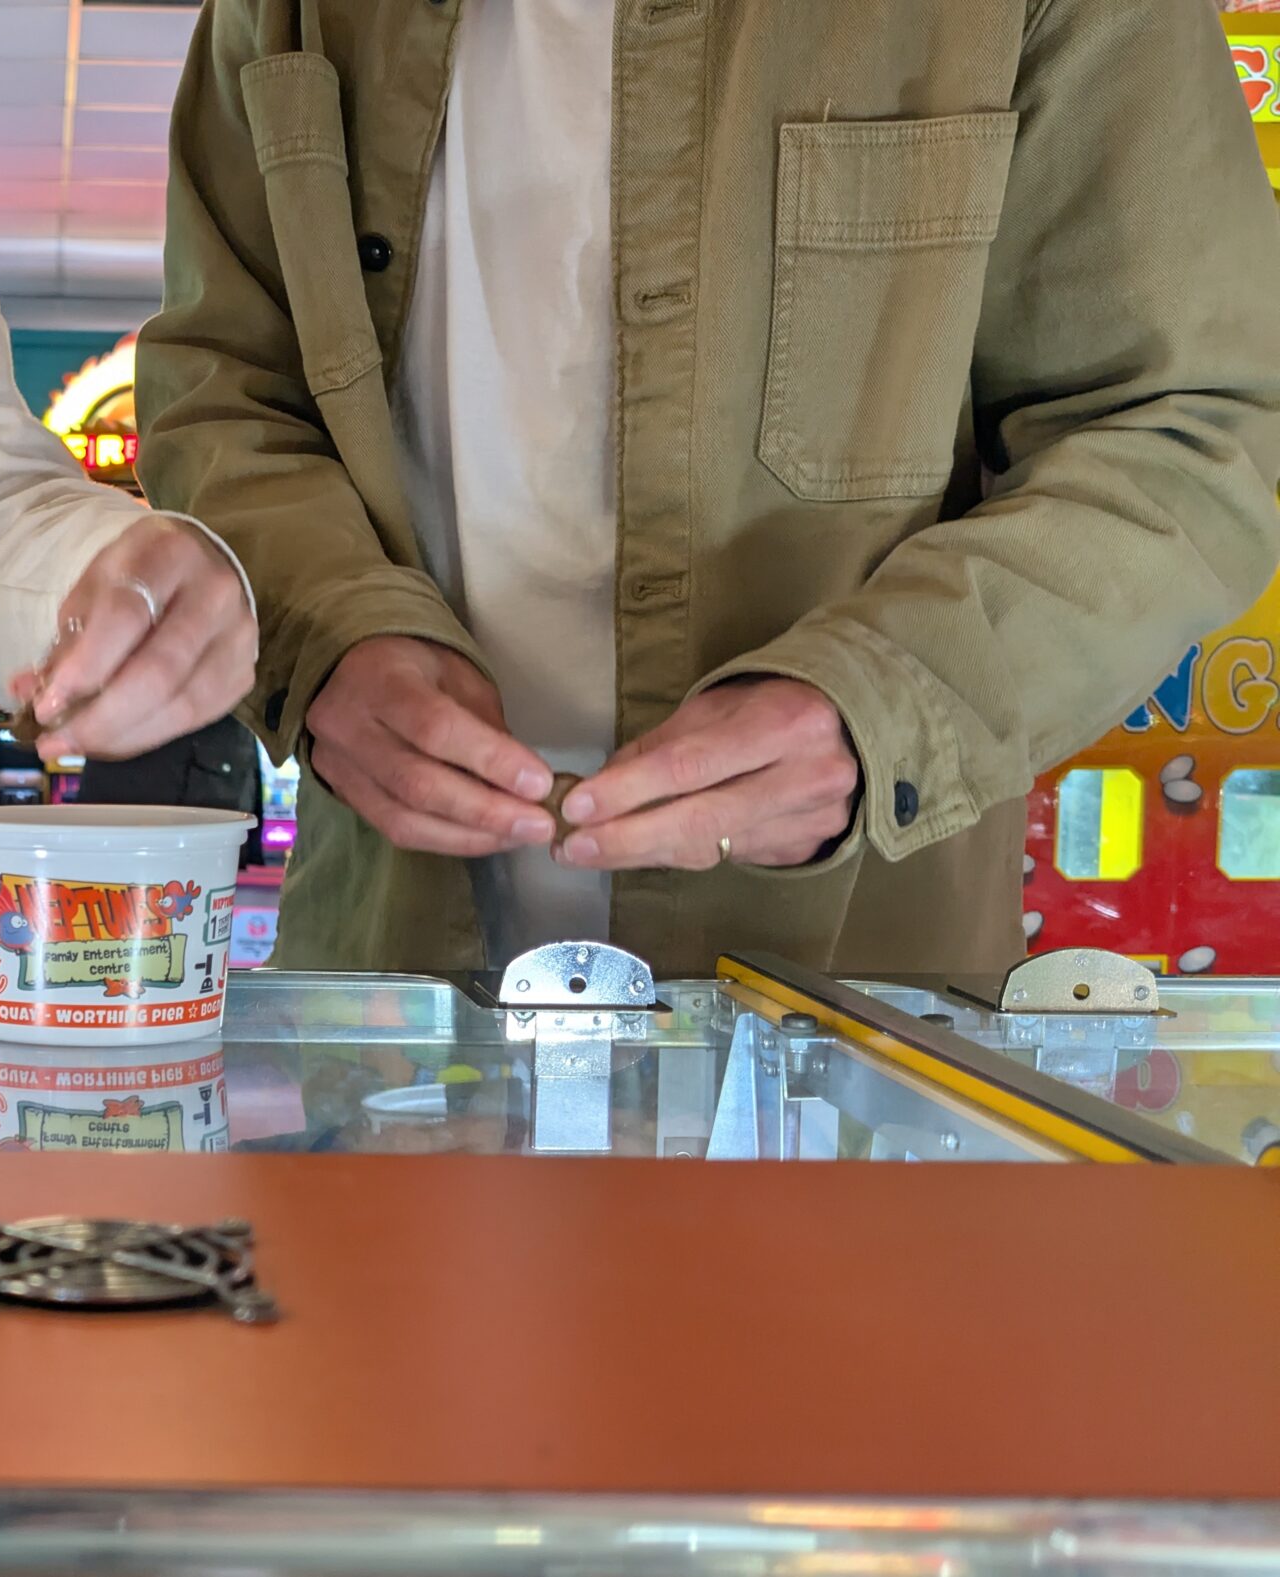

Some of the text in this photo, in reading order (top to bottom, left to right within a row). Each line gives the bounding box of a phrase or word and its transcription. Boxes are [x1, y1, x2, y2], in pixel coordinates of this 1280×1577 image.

[15, 884, 167, 942] NEPTUNES
[44, 949, 79, 963] Family
[56, 1008, 148, 1024] WORTHING
